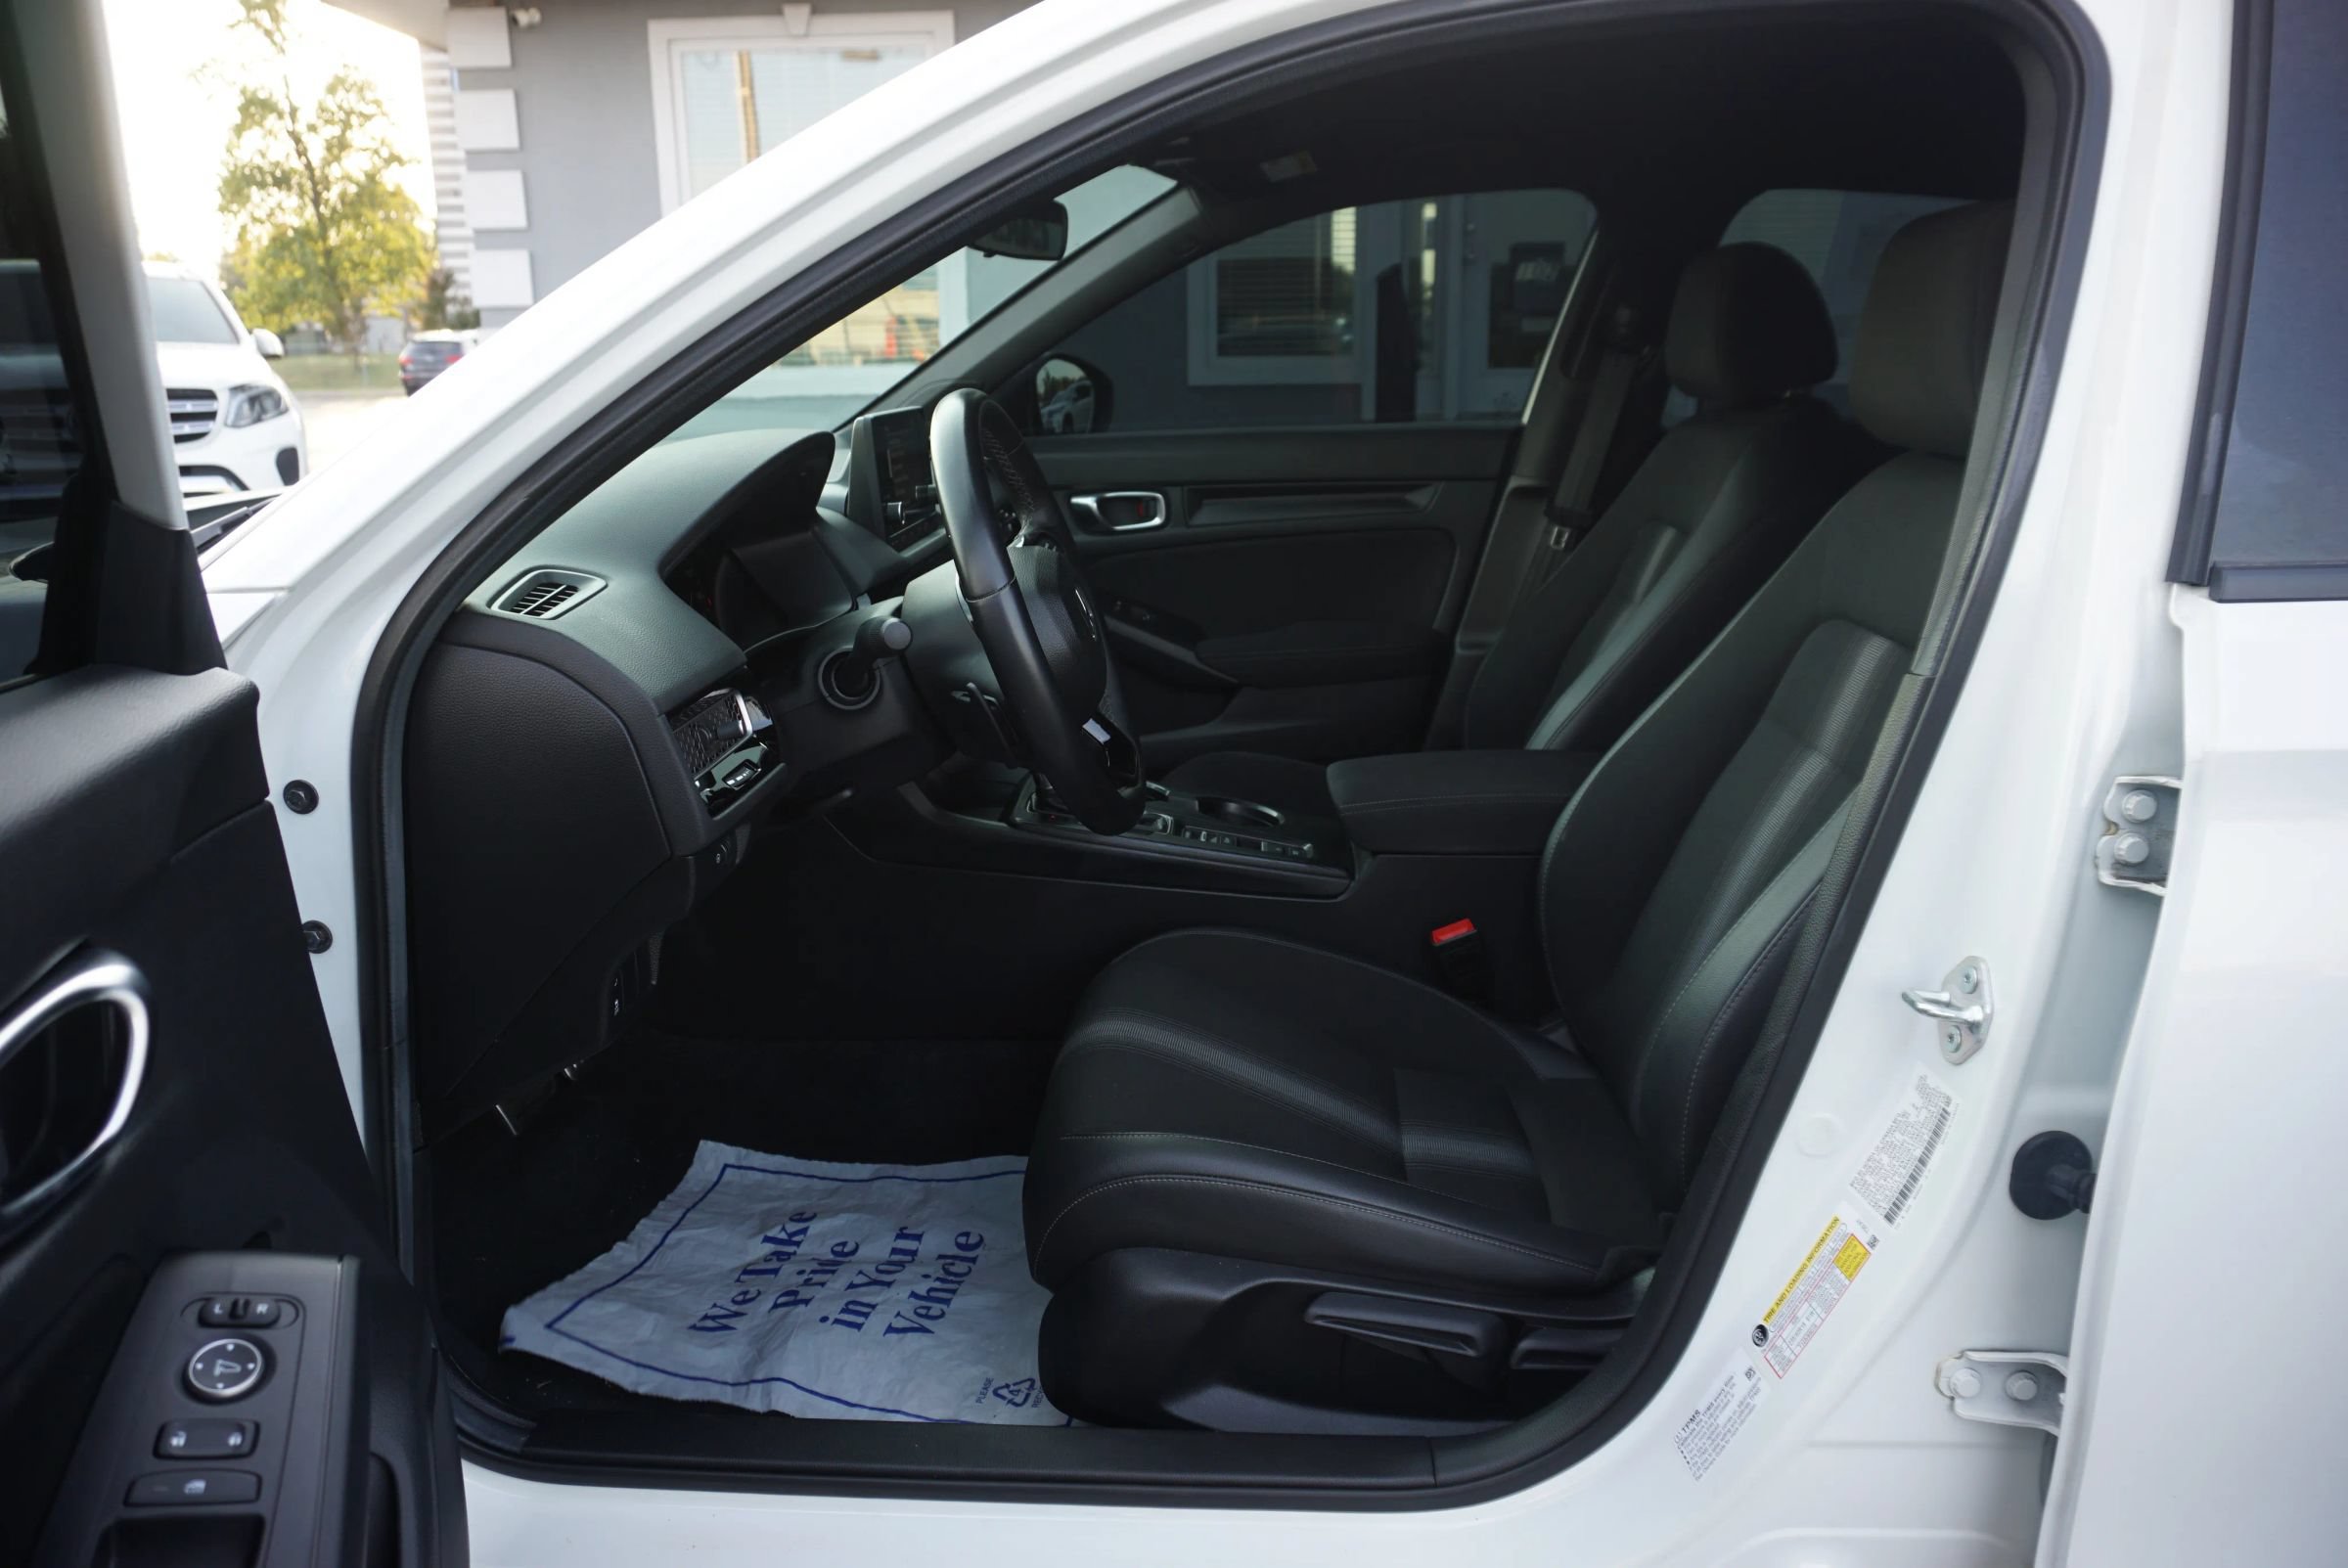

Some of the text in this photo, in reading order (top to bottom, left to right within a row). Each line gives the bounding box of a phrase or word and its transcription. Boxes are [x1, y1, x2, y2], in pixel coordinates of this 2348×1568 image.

[687, 1212, 818, 1333] We Take
[768, 1240, 860, 1314] Pride
[819, 1226, 926, 1332] in Your
[882, 1231, 985, 1337] Vehicle
[1763, 1307, 1777, 1323] TIRE
[1776, 1293, 1787, 1307] AND
[1785, 1264, 1809, 1292] LOADING
[1807, 1216, 1841, 1265] INFORMATION
[213, 1303, 223, 1315] L
[256, 1303, 269, 1315] R
[975, 1377, 994, 1405] PLEASE
[1682, 1409, 1701, 1433] TPMS
